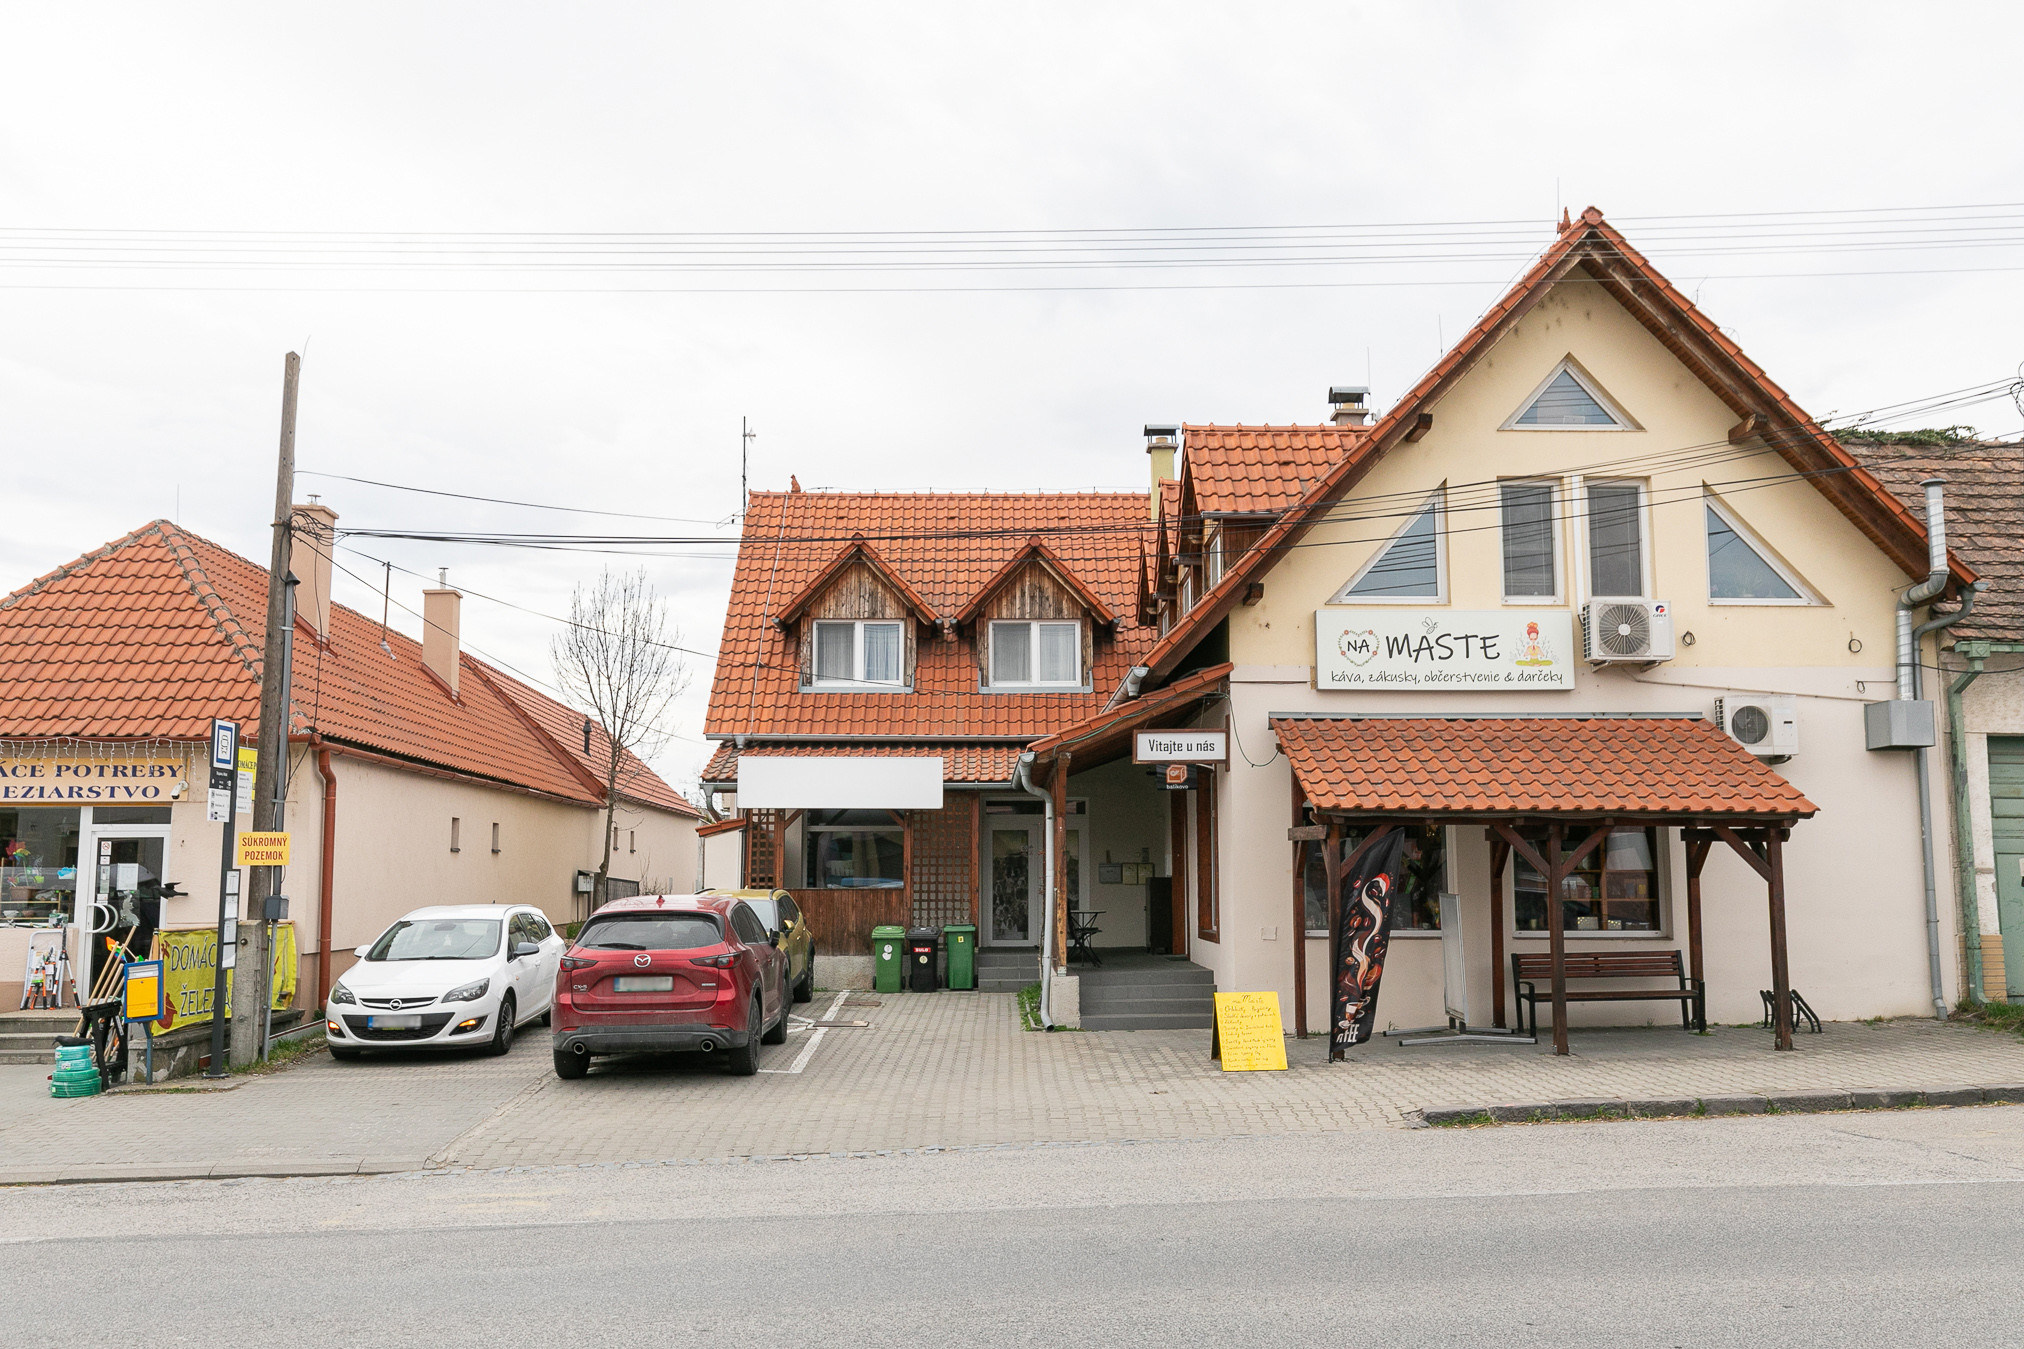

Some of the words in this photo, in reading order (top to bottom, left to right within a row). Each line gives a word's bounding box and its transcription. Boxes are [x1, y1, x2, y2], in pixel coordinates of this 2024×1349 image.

[1347, 638, 1370, 654] NA
[1386, 633, 1501, 664] MASTE
[1331, 670, 1365, 684] káva,
[1368, 670, 1421, 685] zákusky,
[1424, 669, 1500, 683] občerstvenie
[1504, 671, 1514, 682] &
[1517, 669, 1563, 685] darčeky
[1148, 739, 1183, 755] Vitajte
[1186, 743, 1193, 752] u
[1196, 740, 1215, 752] nás
[55, 764, 183, 778] POTREBY
[3, 785, 160, 799] EZIARSTVO
[242, 835, 288, 847] SÚKROMNÝ
[244, 851, 284, 861] POZEMOK
